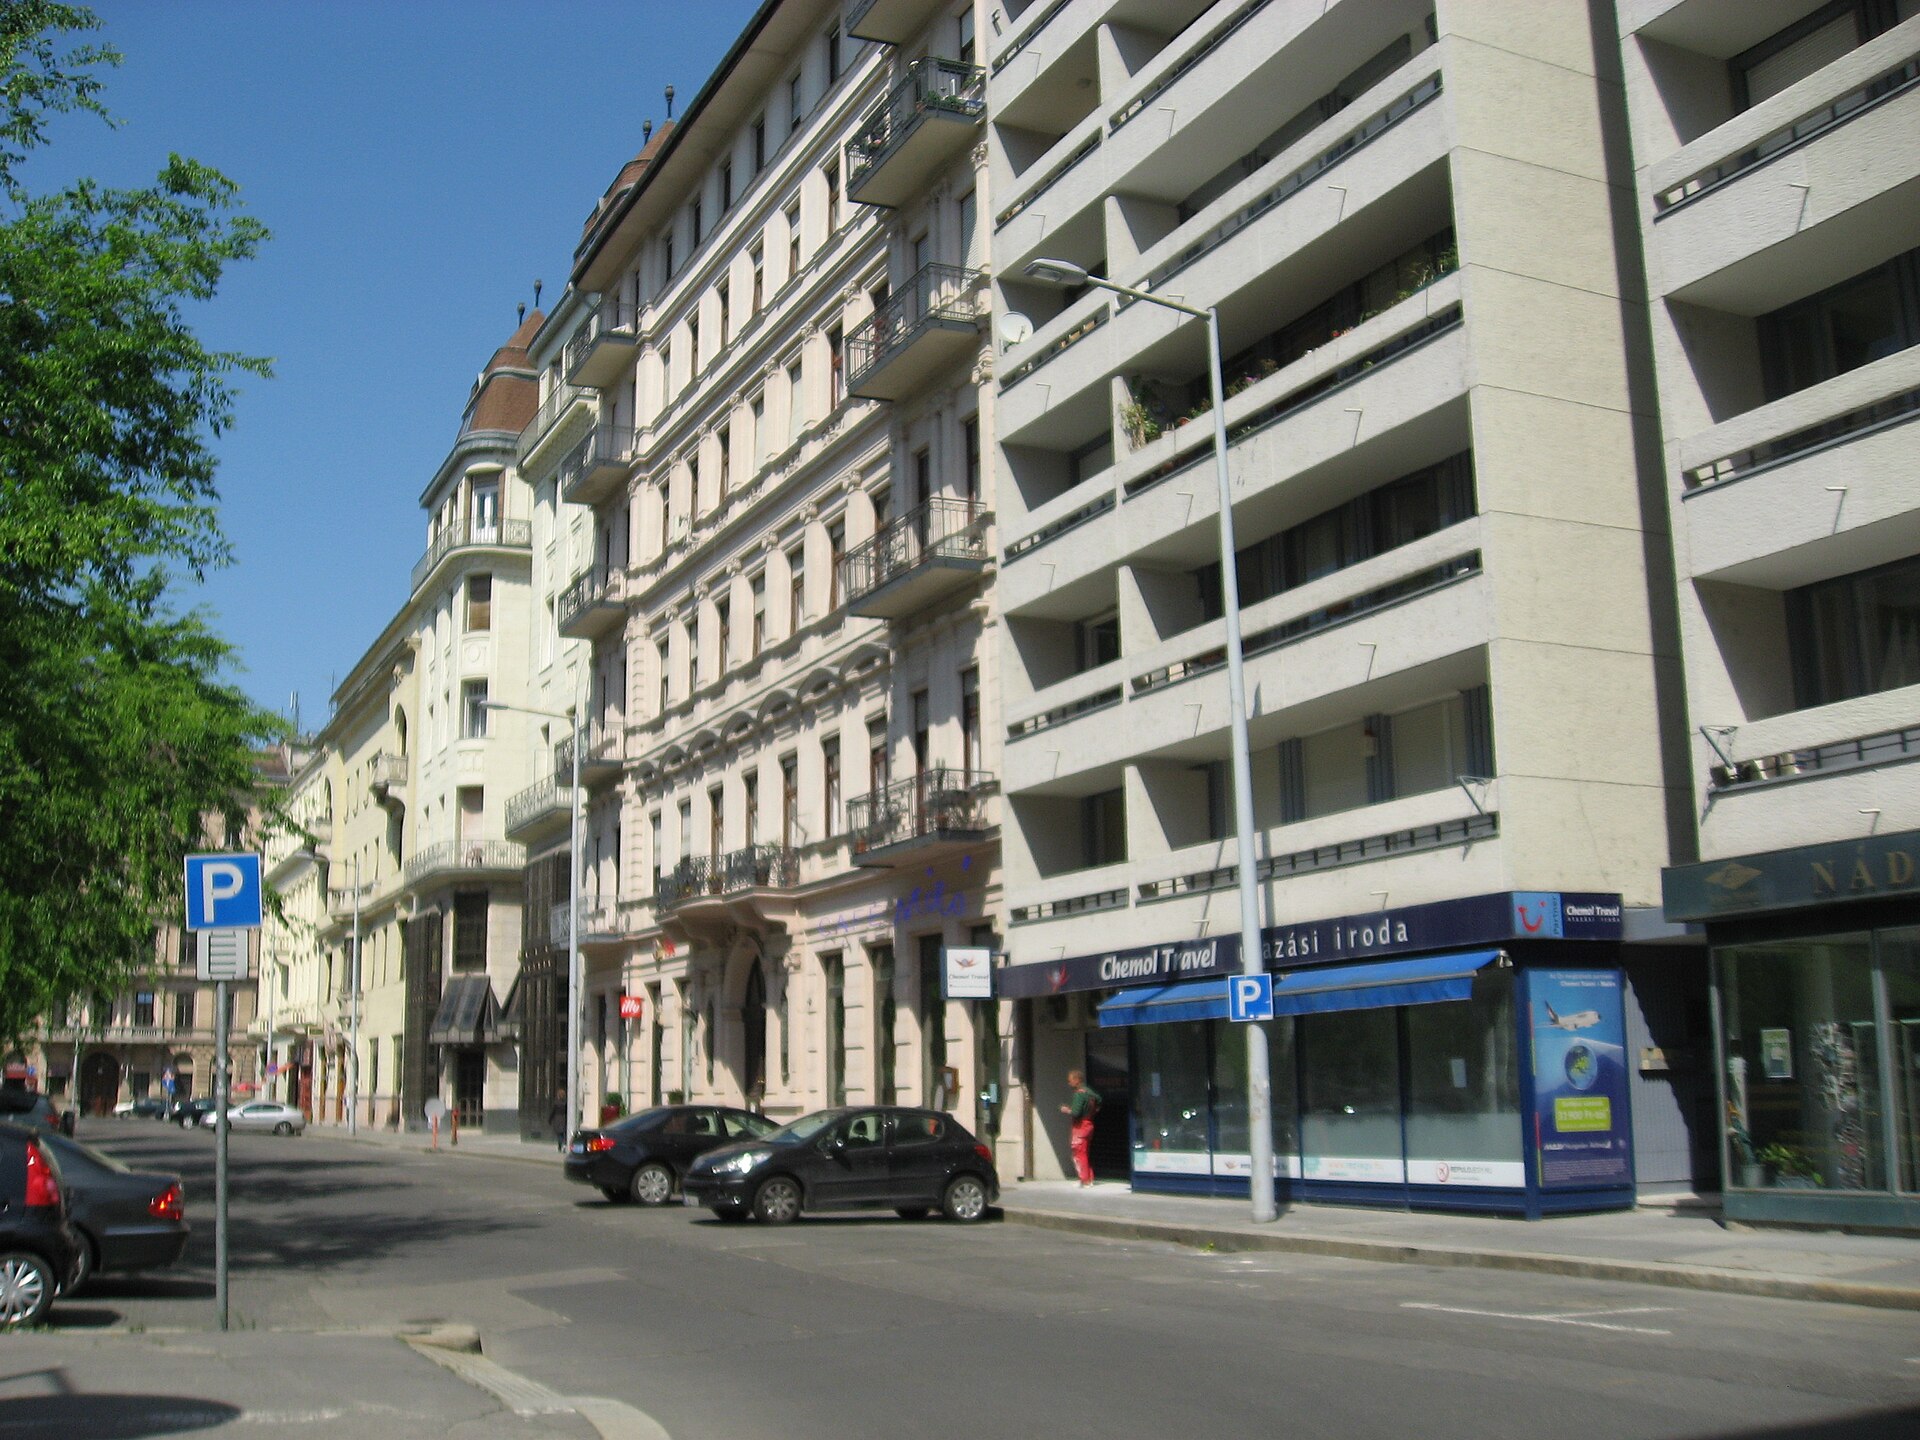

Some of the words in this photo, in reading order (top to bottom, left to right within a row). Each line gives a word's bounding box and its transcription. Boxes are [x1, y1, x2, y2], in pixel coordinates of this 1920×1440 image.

[203, 863, 243, 923] P
[1566, 905, 1594, 916] Chemol
[1595, 905, 1619, 916] Travel
[1101, 949, 1159, 982] Chemol
[1161, 941, 1217, 972] Travel
[1336, 918, 1408, 950] iroda
[621, 999, 640, 1014] illy
[1237, 980, 1262, 1017] P
